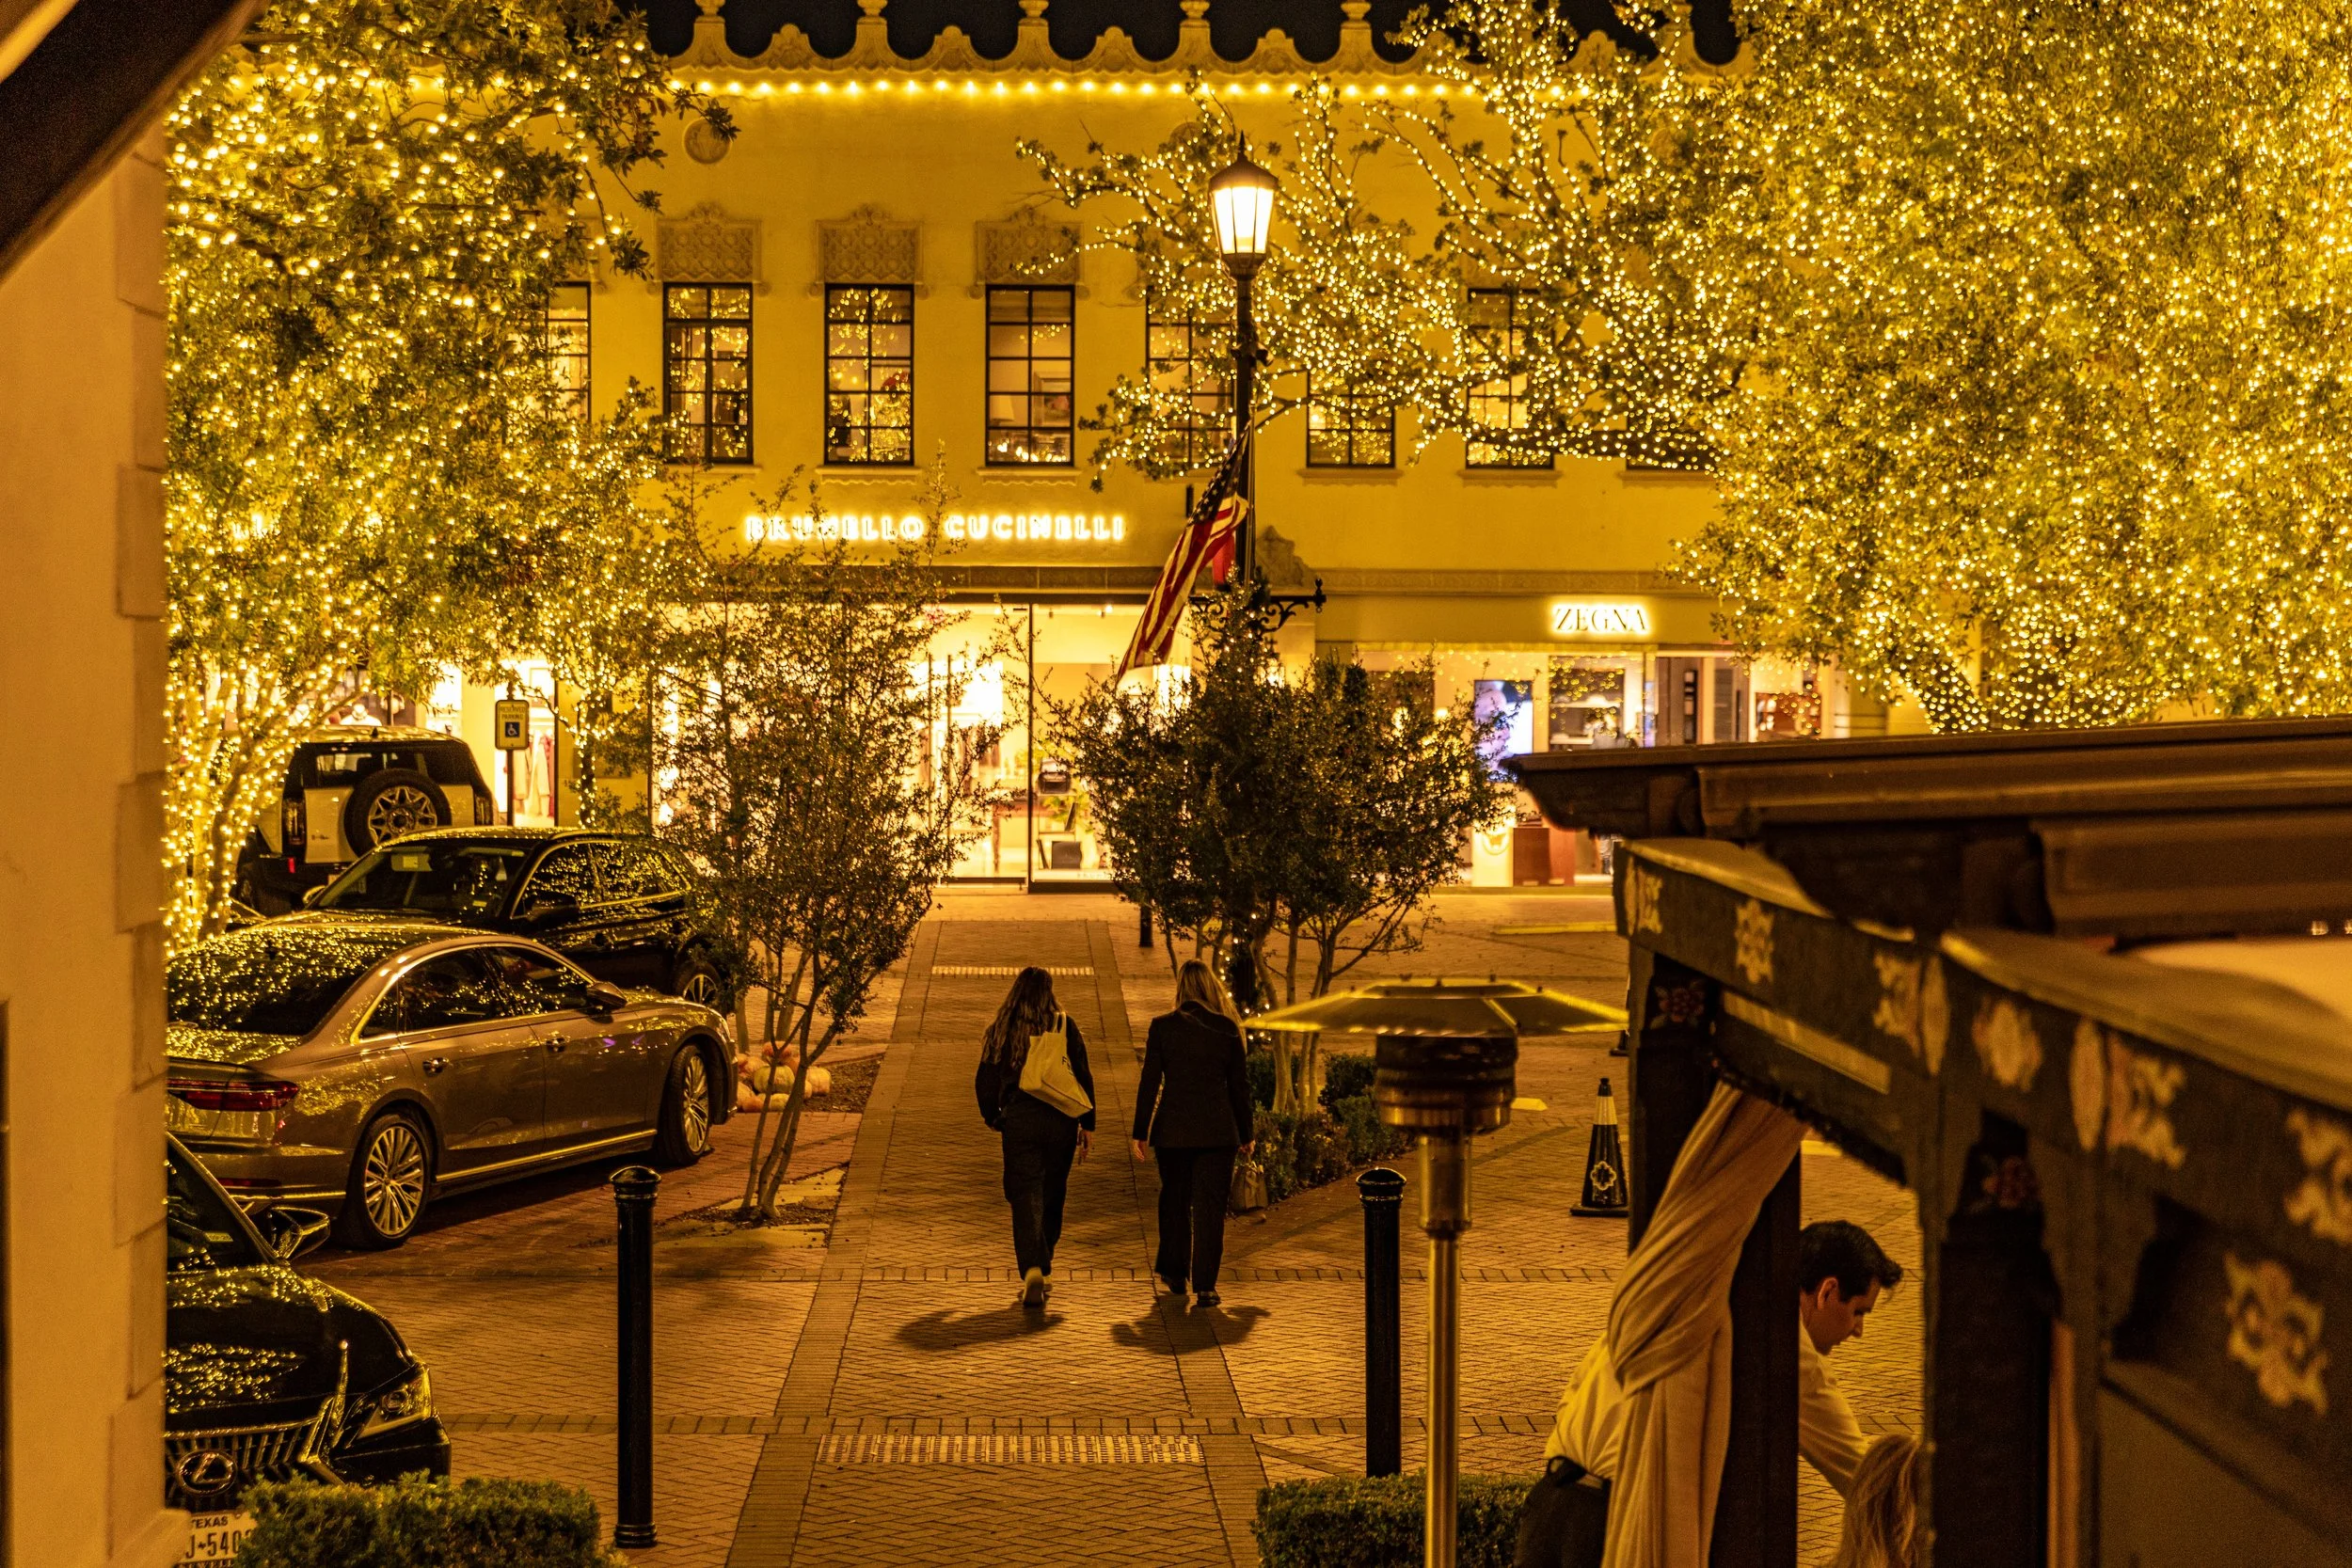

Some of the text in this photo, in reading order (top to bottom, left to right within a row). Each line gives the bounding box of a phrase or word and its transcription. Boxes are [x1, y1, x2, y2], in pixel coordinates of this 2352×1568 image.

[745, 515, 1125, 541] BRUNELLO CUCINELLI
[1552, 607, 1647, 632] ZEGNA
